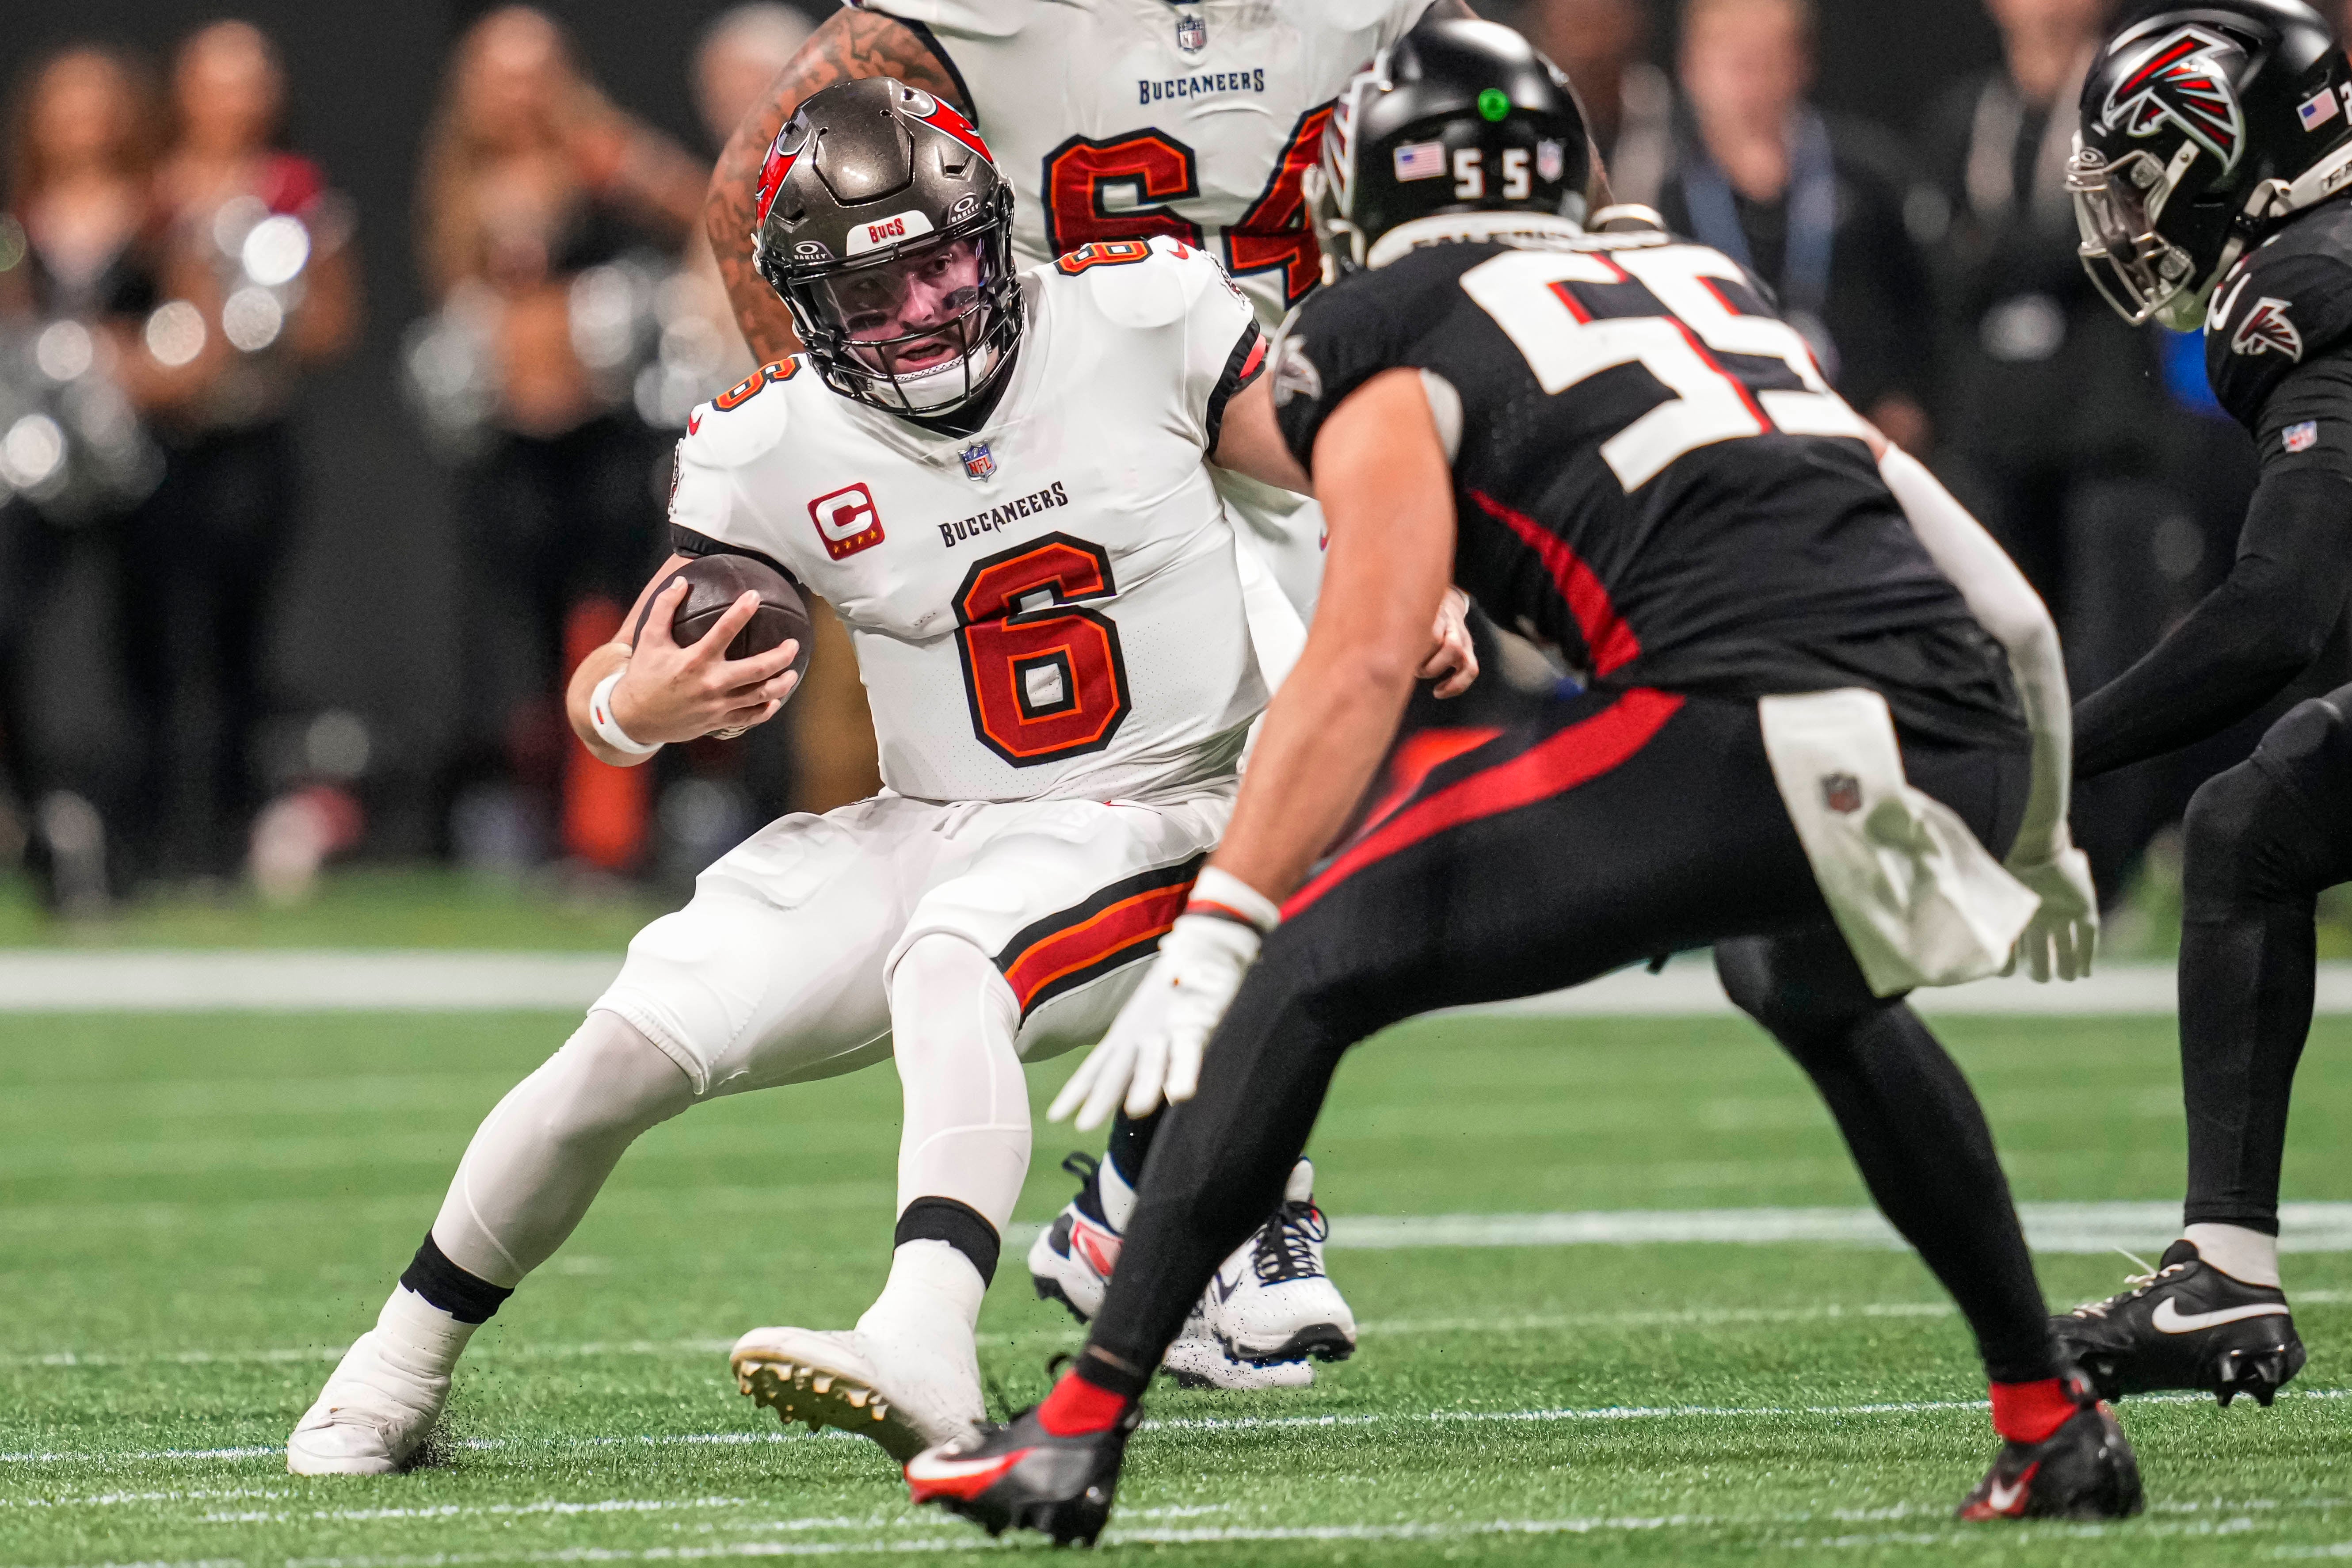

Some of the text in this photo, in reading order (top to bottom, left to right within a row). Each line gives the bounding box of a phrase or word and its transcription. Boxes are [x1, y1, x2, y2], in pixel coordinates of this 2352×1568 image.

[1139, 68, 1265, 105] BUCCANEERS
[1453, 148, 1530, 199] 55
[951, 203, 979, 222] OAKLEY
[1041, 97, 1333, 311] 64
[868, 218, 905, 243] BUCS
[1459, 244, 1869, 494] 55
[968, 456, 993, 474] NFL
[816, 489, 873, 542] C
[938, 481, 1068, 548] BUCCANEERS
[951, 530, 1132, 769] 6
